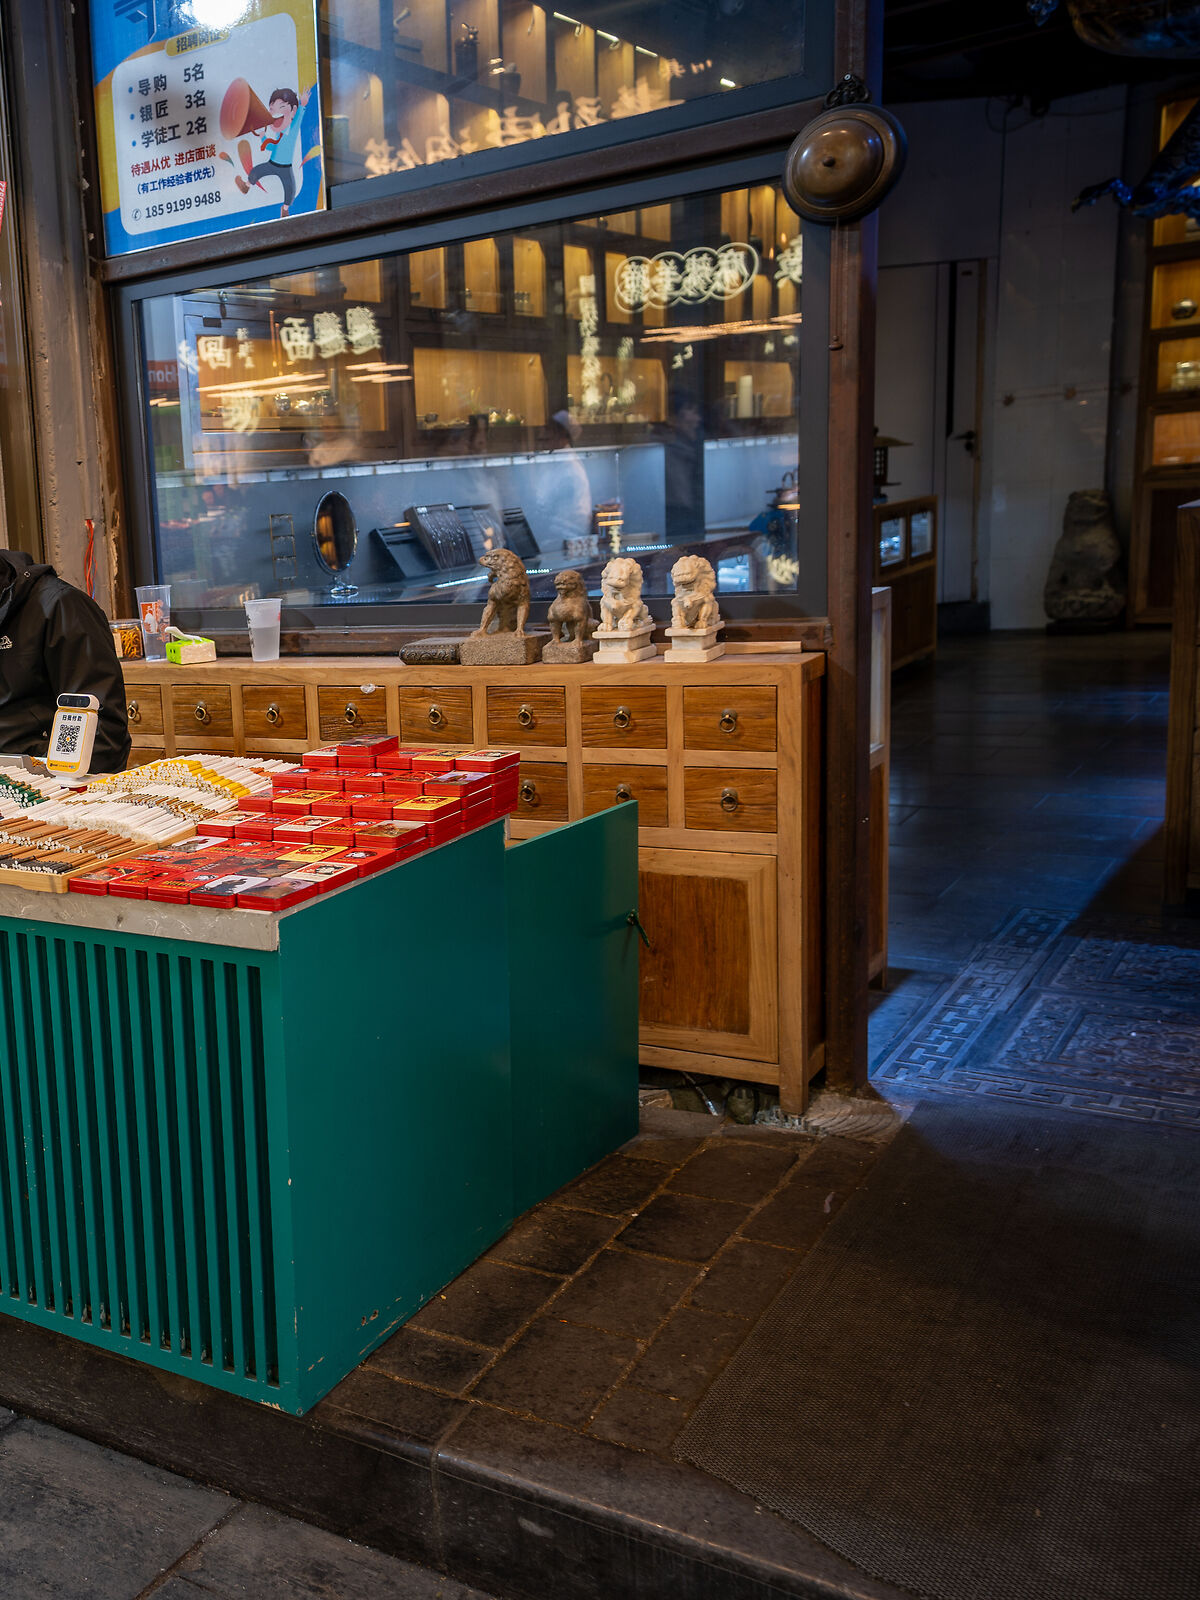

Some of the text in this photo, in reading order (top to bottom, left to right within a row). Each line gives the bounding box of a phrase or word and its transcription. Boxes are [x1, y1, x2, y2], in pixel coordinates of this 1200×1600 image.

[138, 63, 204, 96] 导购 5名
[140, 89, 206, 123] 银匠 3名
[141, 116, 207, 148] 学徒工 2名
[131, 144, 216, 177] 待遇从优 进店面谈
[145, 190, 222, 219] 185 9199 9488
